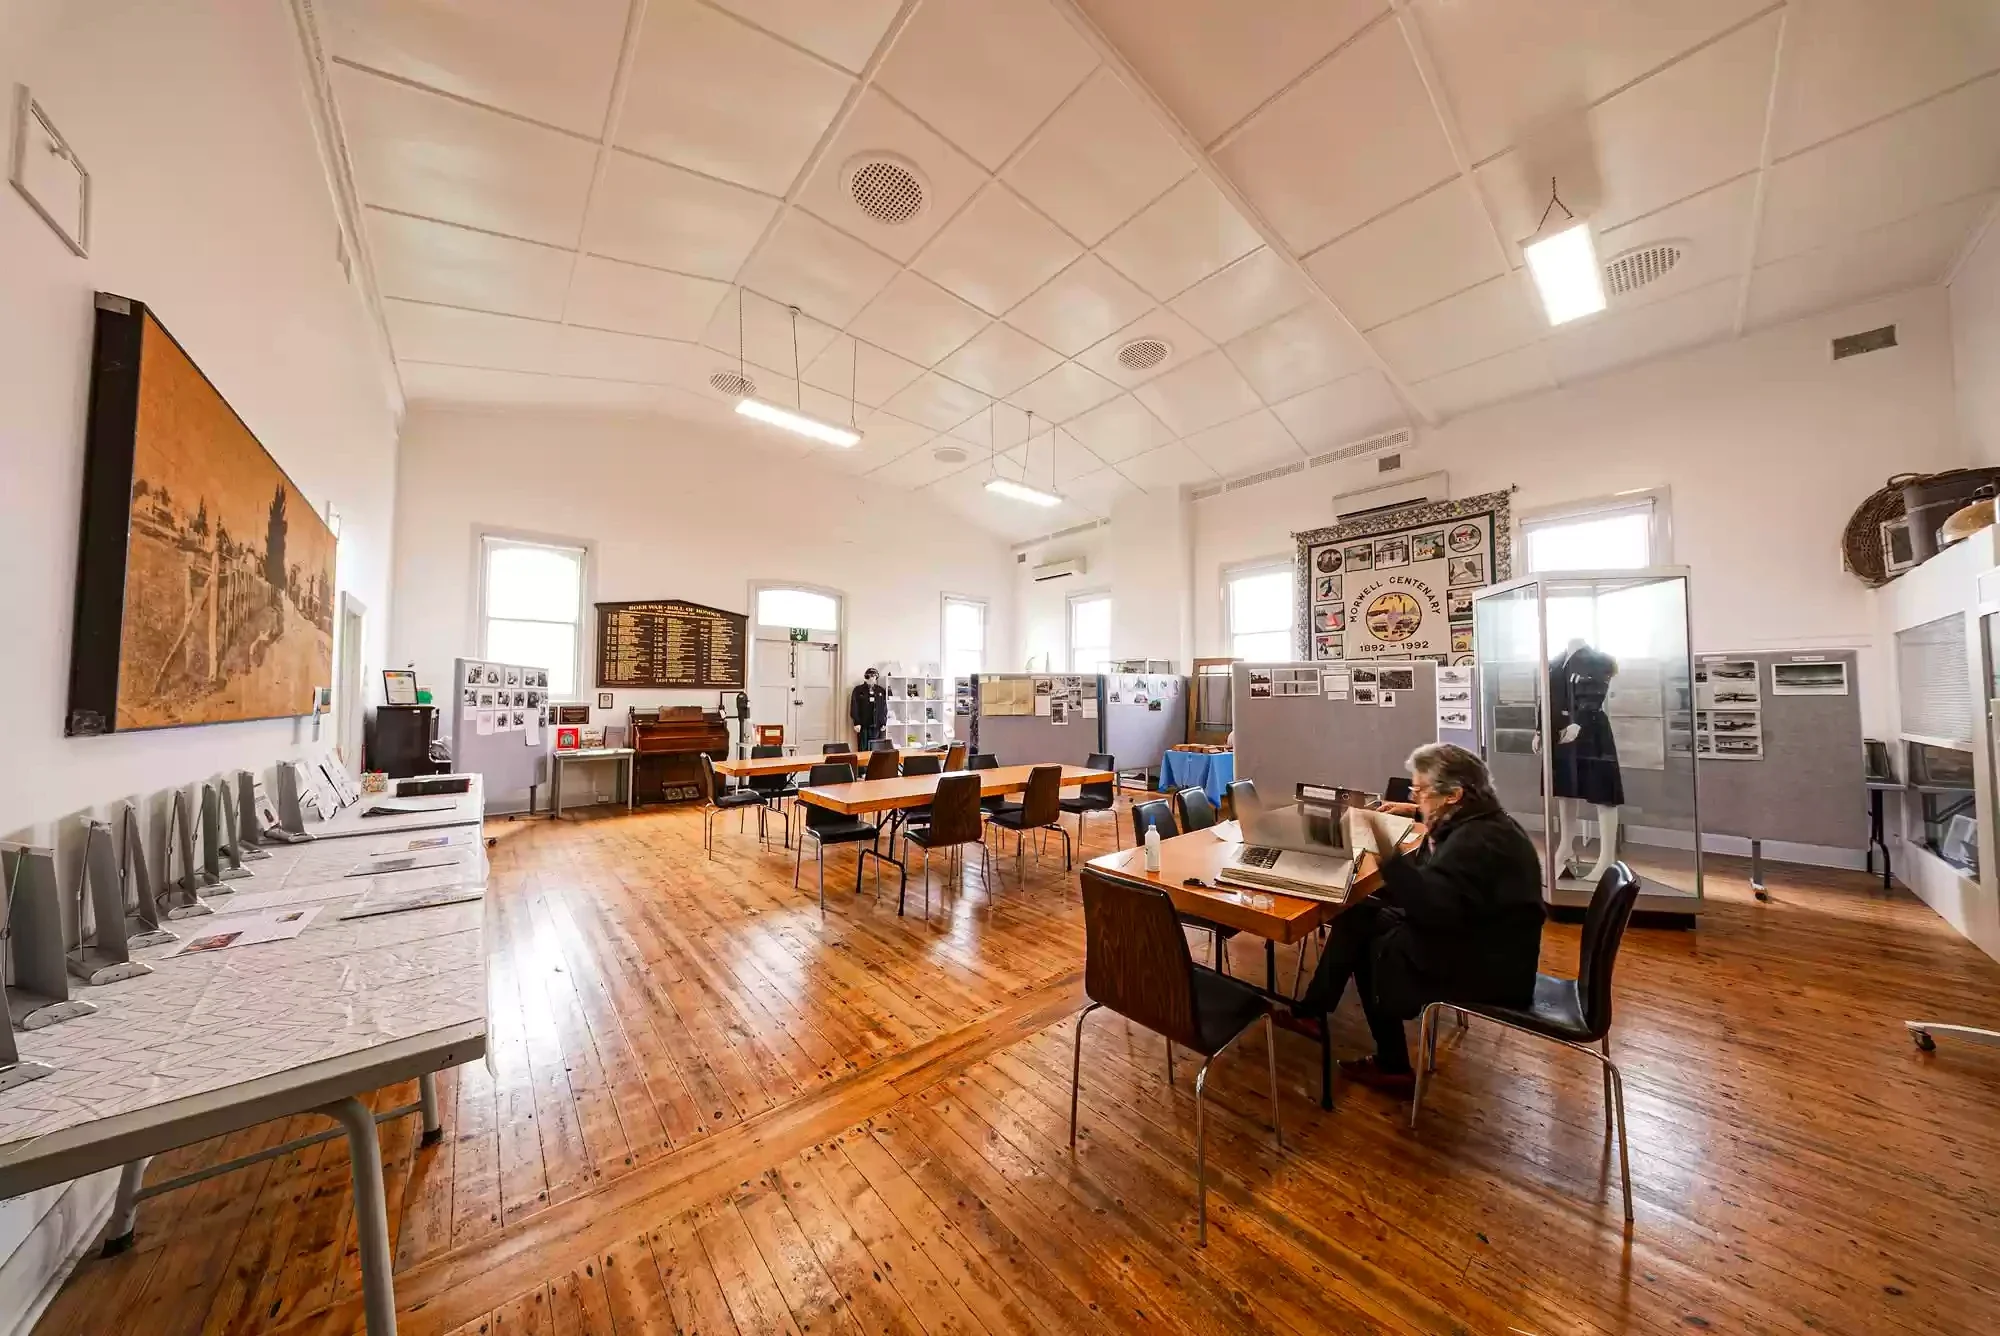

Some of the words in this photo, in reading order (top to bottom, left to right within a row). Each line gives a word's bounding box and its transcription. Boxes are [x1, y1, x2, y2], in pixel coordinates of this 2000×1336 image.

[1349, 580, 1384, 623] MORWELL
[1389, 576, 1441, 615] CENTENARY
[791, 627, 807, 636] EXIT
[1360, 644, 1385, 653] 1892
[1401, 640, 1430, 650] 1992
